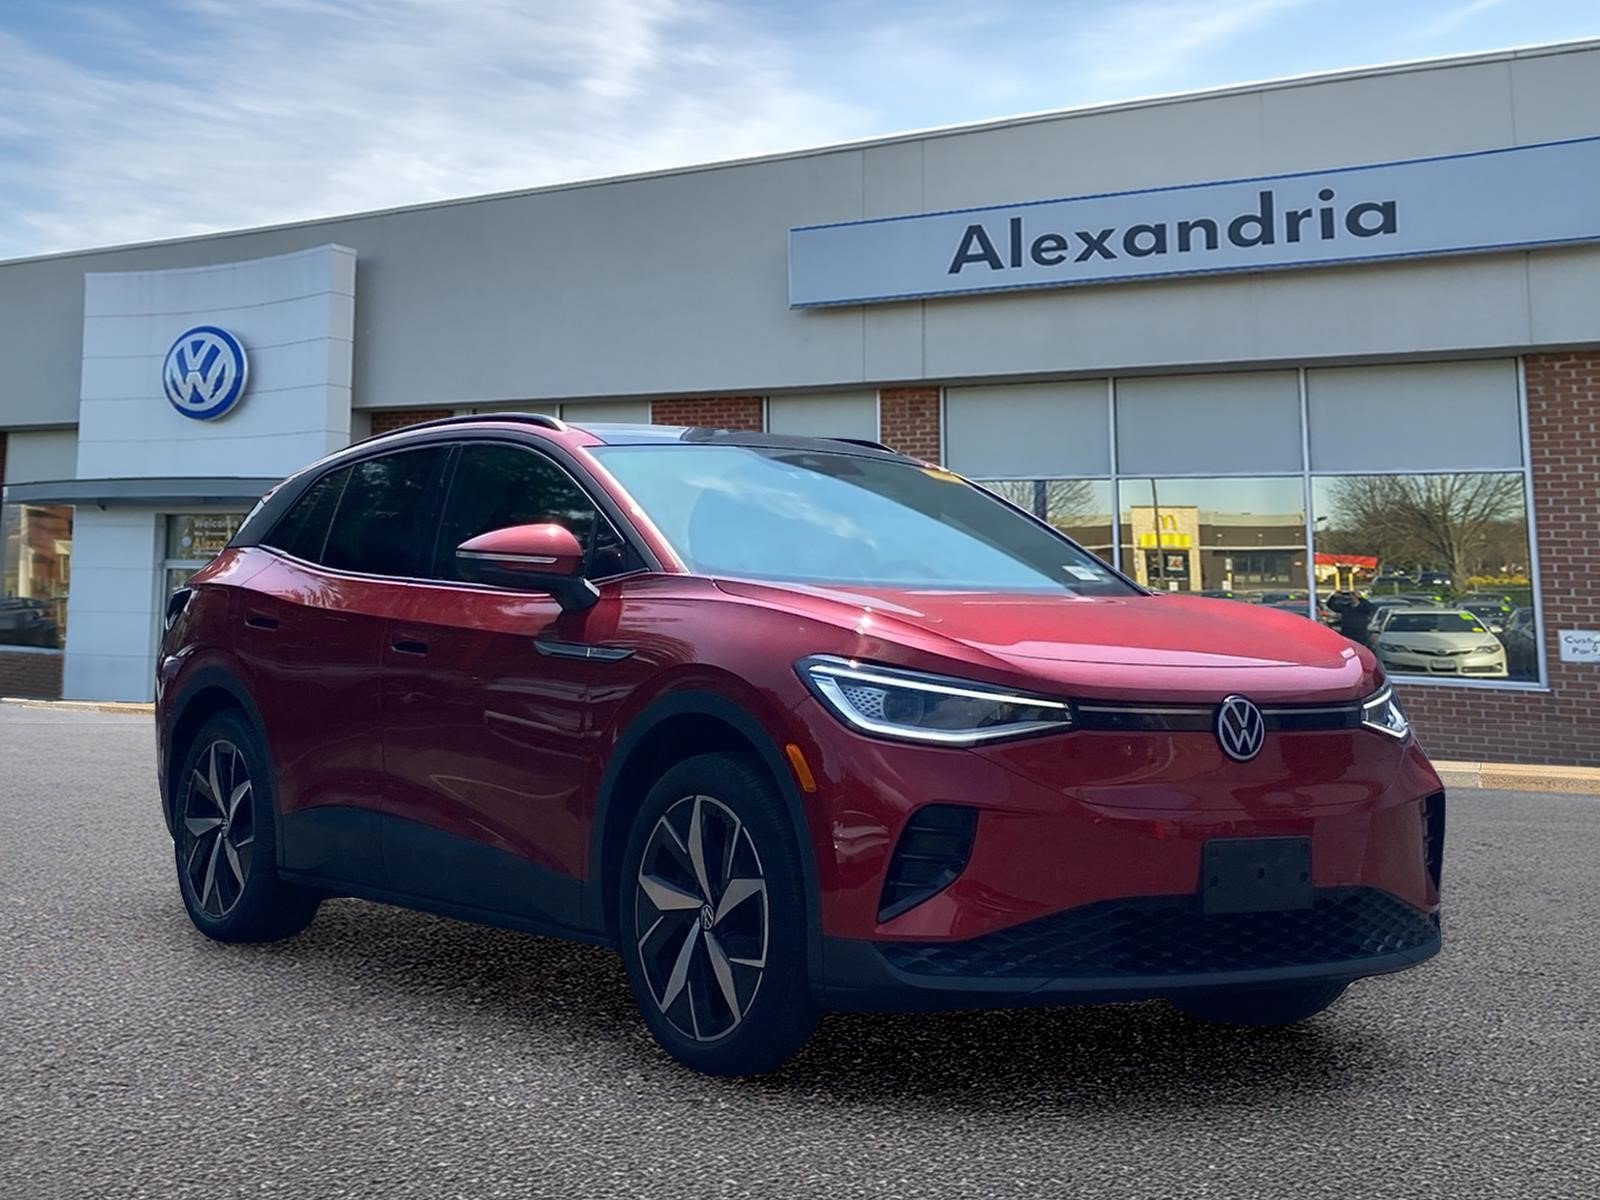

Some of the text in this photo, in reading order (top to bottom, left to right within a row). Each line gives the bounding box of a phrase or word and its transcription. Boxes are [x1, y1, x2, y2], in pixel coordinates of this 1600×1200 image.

[947, 188, 1397, 275] Alexandria
[168, 331, 239, 414] VW
[1219, 698, 1263, 758] VW
